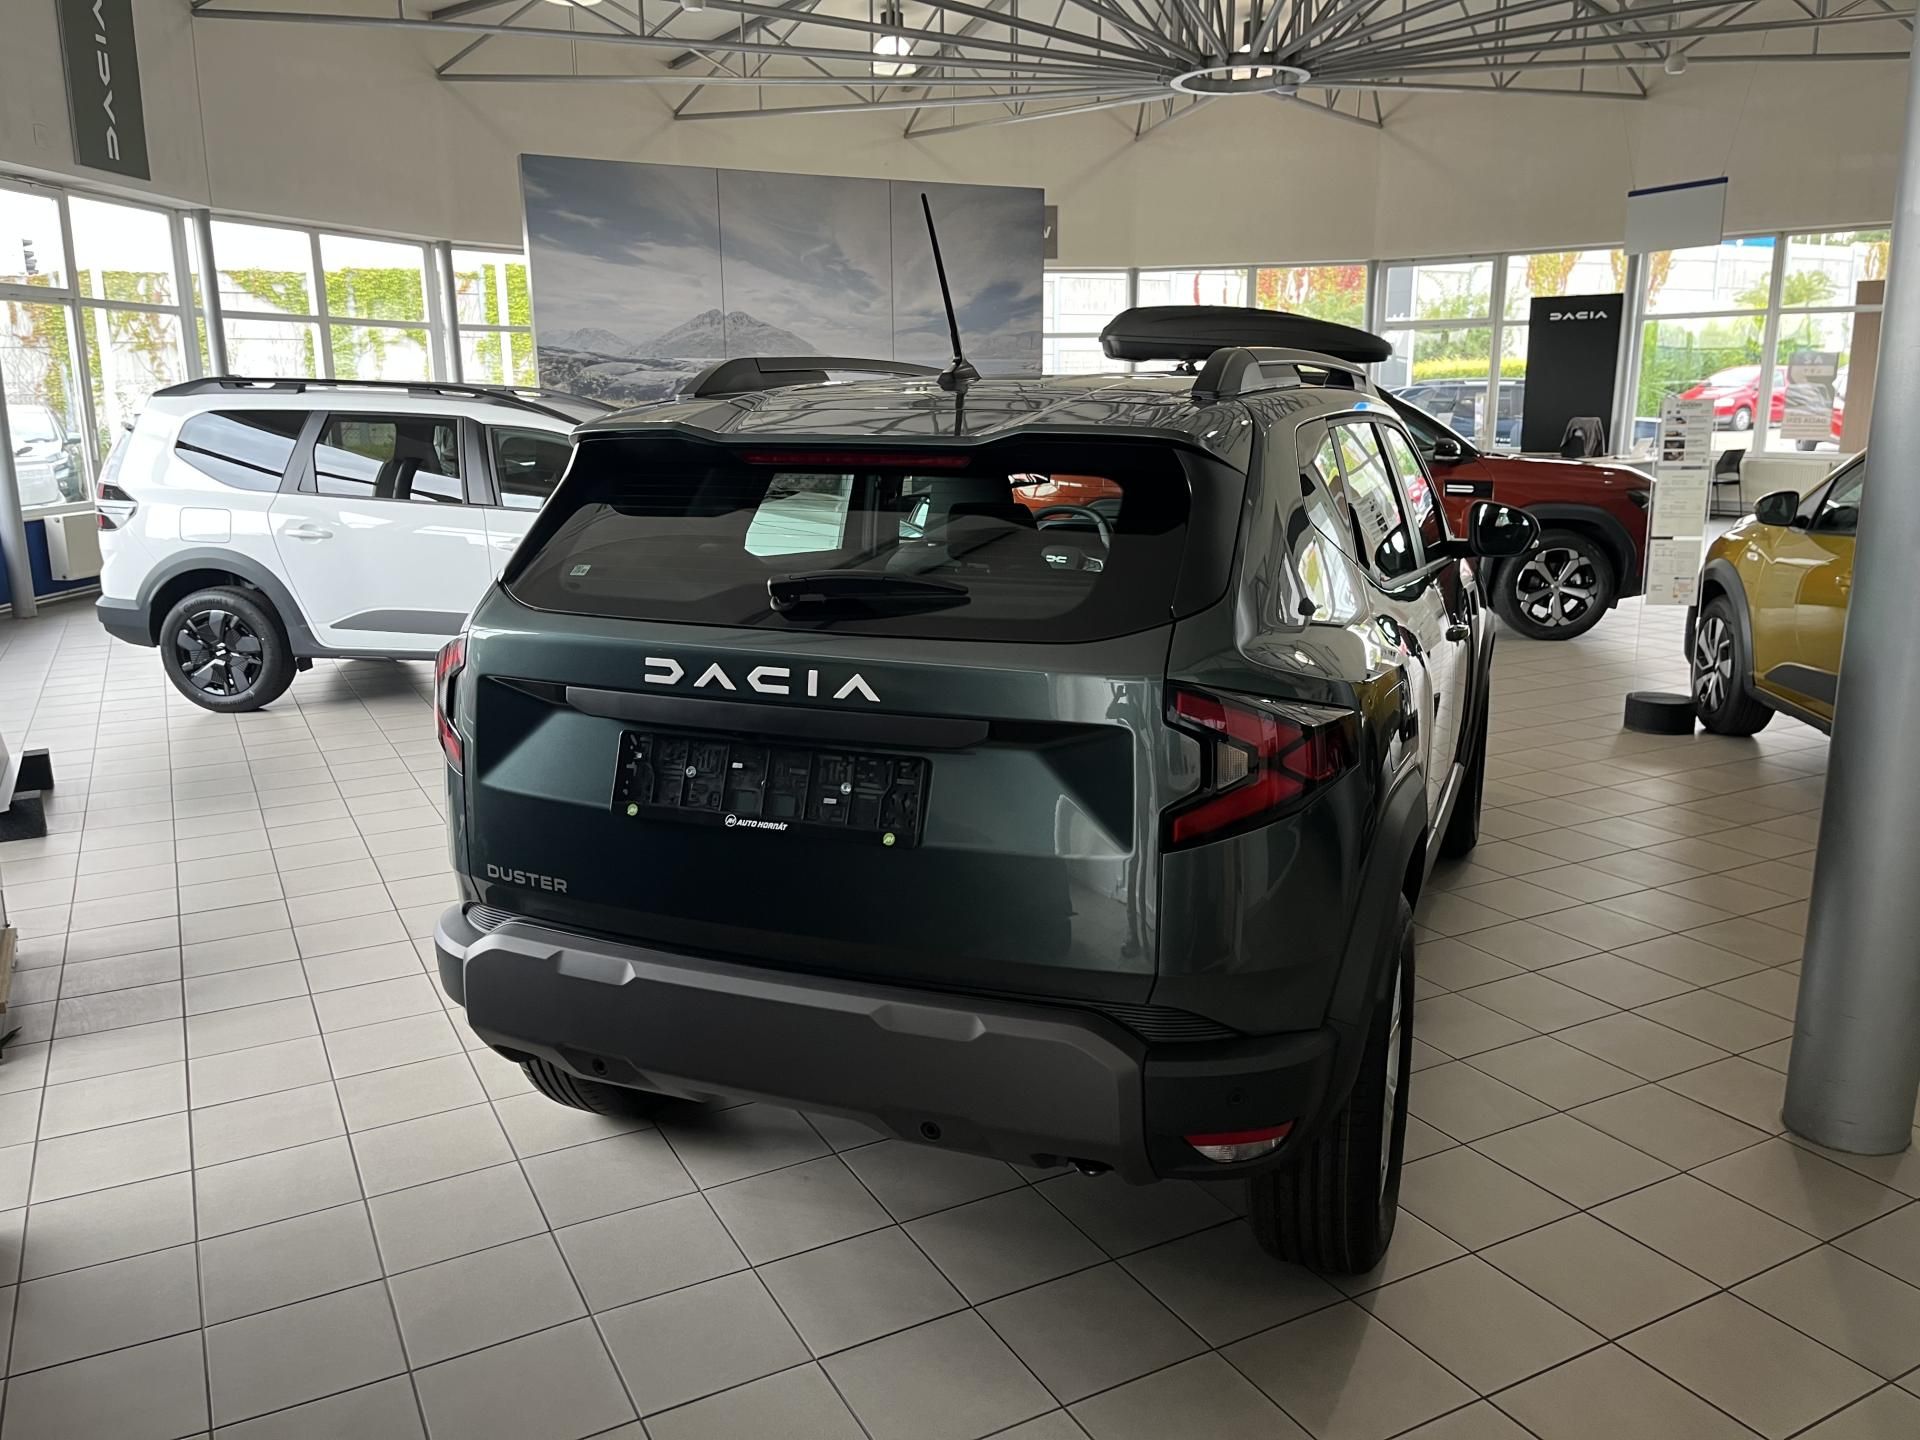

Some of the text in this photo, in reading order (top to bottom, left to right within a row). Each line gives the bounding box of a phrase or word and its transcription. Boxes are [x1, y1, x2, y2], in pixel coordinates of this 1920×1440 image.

[92, 0, 120, 161] DACIA
[1549, 310, 1608, 321] DACIA
[644, 656, 882, 703] DACIA
[736, 819, 758, 828] AUTO
[486, 863, 567, 893] DUSTER
